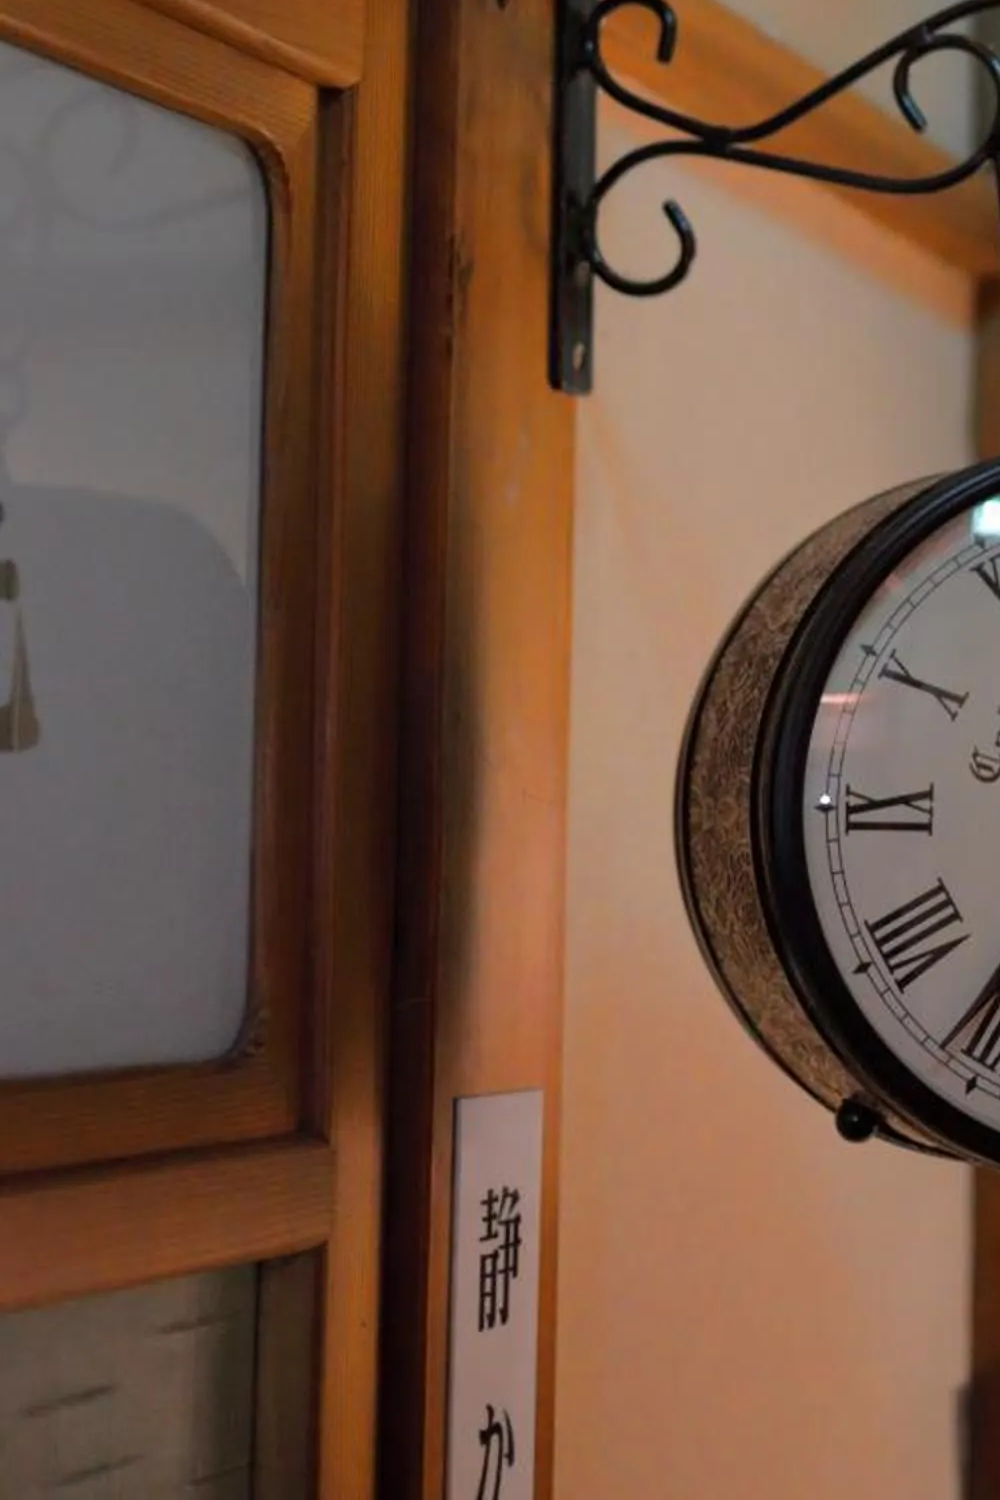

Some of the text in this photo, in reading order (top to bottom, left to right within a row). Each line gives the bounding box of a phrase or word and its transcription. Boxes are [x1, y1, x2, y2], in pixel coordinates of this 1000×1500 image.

[877, 649, 970, 721] X
[845, 782, 934, 836] IX
[864, 877, 972, 994] VIII
